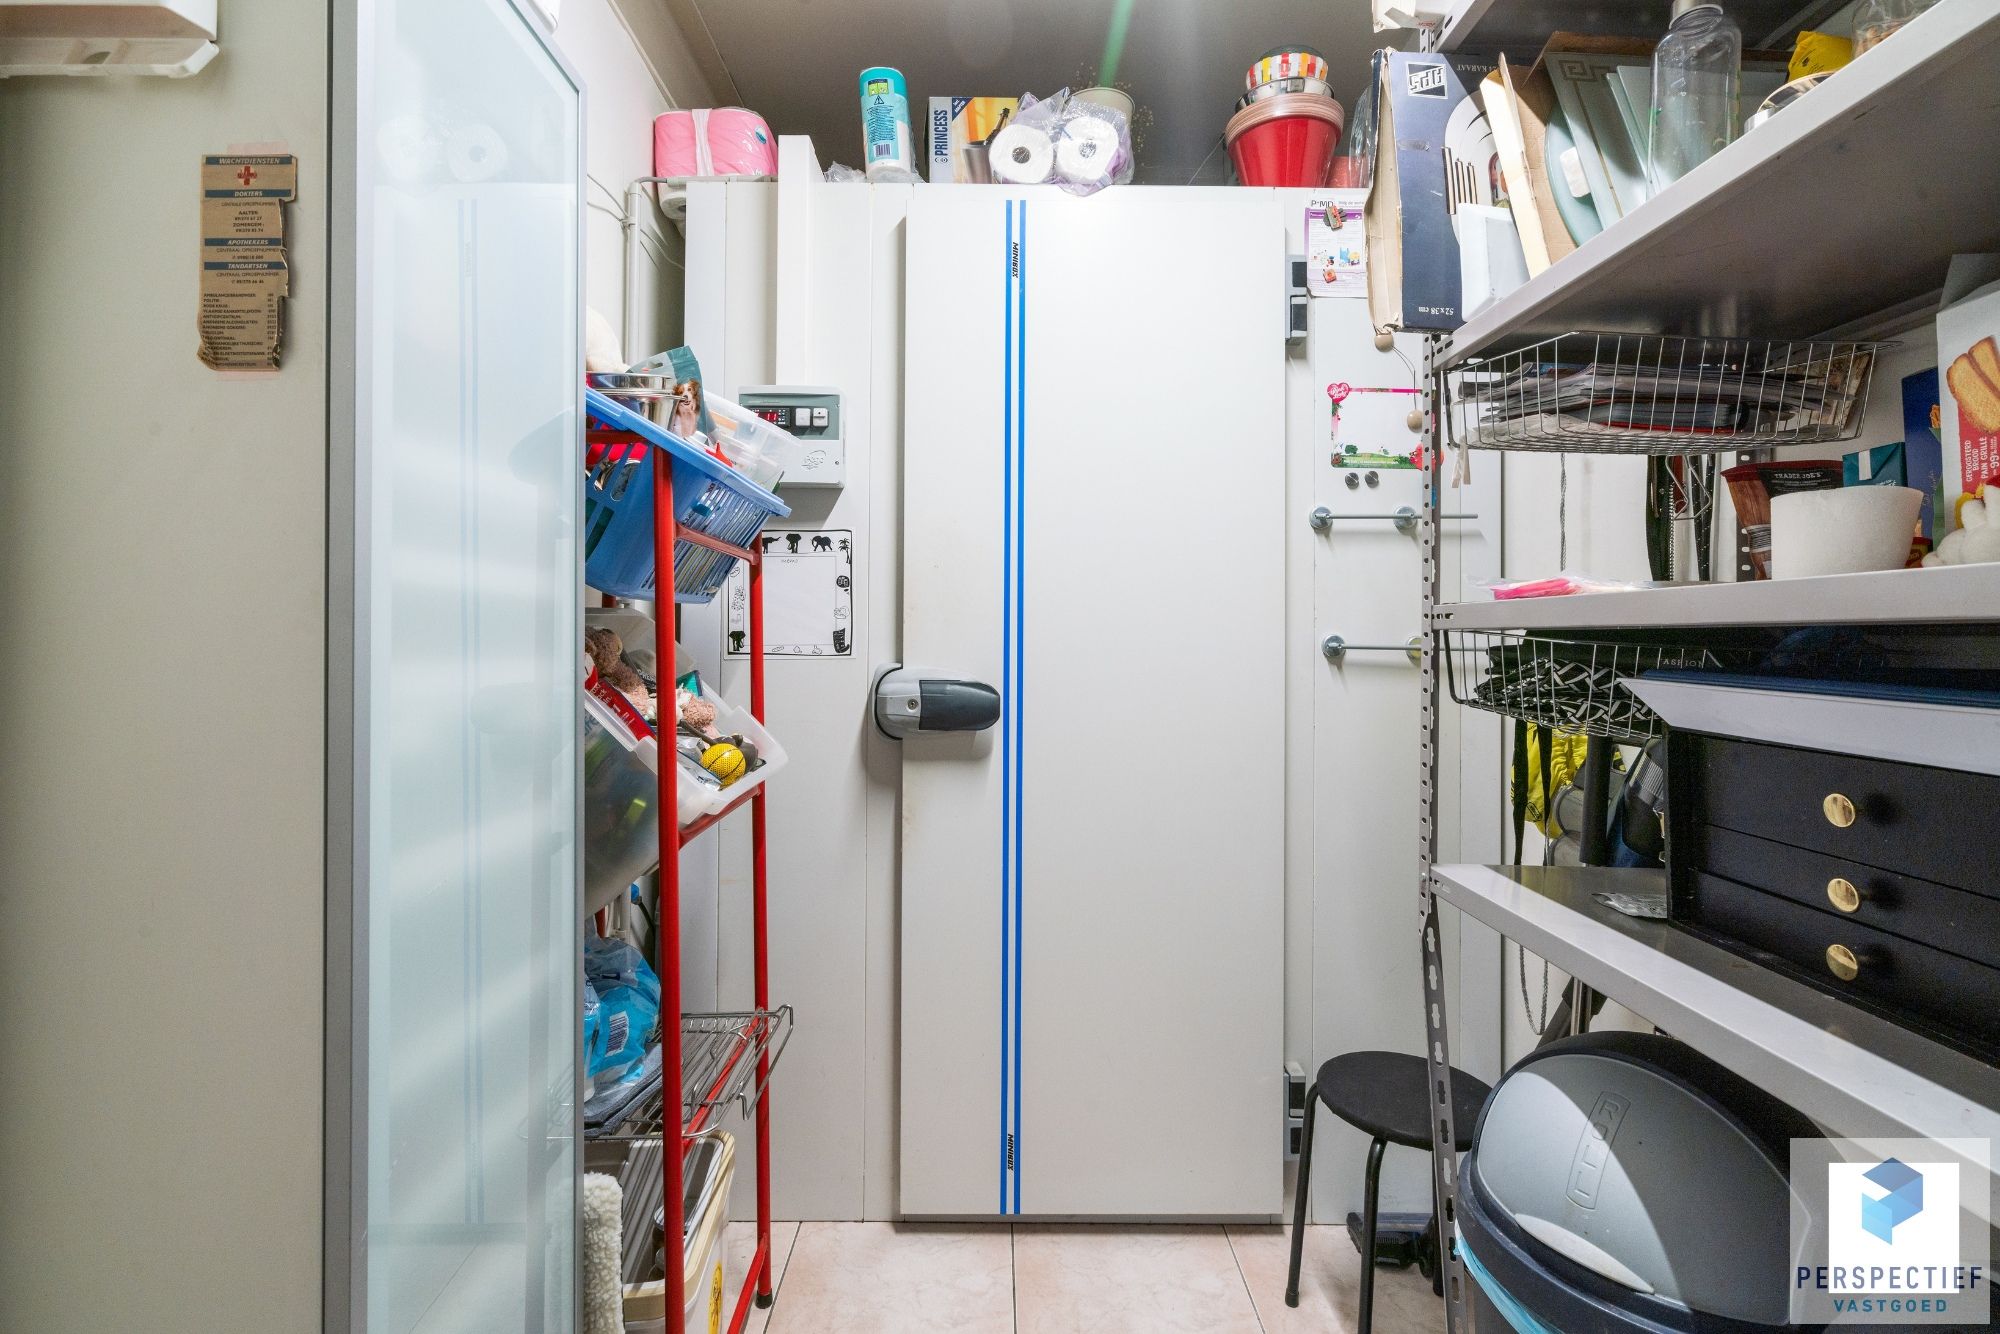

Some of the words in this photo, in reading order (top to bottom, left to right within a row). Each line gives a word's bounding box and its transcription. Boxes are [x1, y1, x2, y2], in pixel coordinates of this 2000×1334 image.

[1456, 63, 1487, 72] KARAAT
[1408, 67, 1444, 92] APS
[933, 109, 948, 156] PRINCESS
[219, 157, 280, 165] WACHTDIENSTEN
[1965, 440, 1973, 482] GEROOSTERD
[1980, 462, 1989, 479] PAIN
[1657, 658, 1704, 668] ASHION
[1574, 1098, 1621, 1199] ROLL
